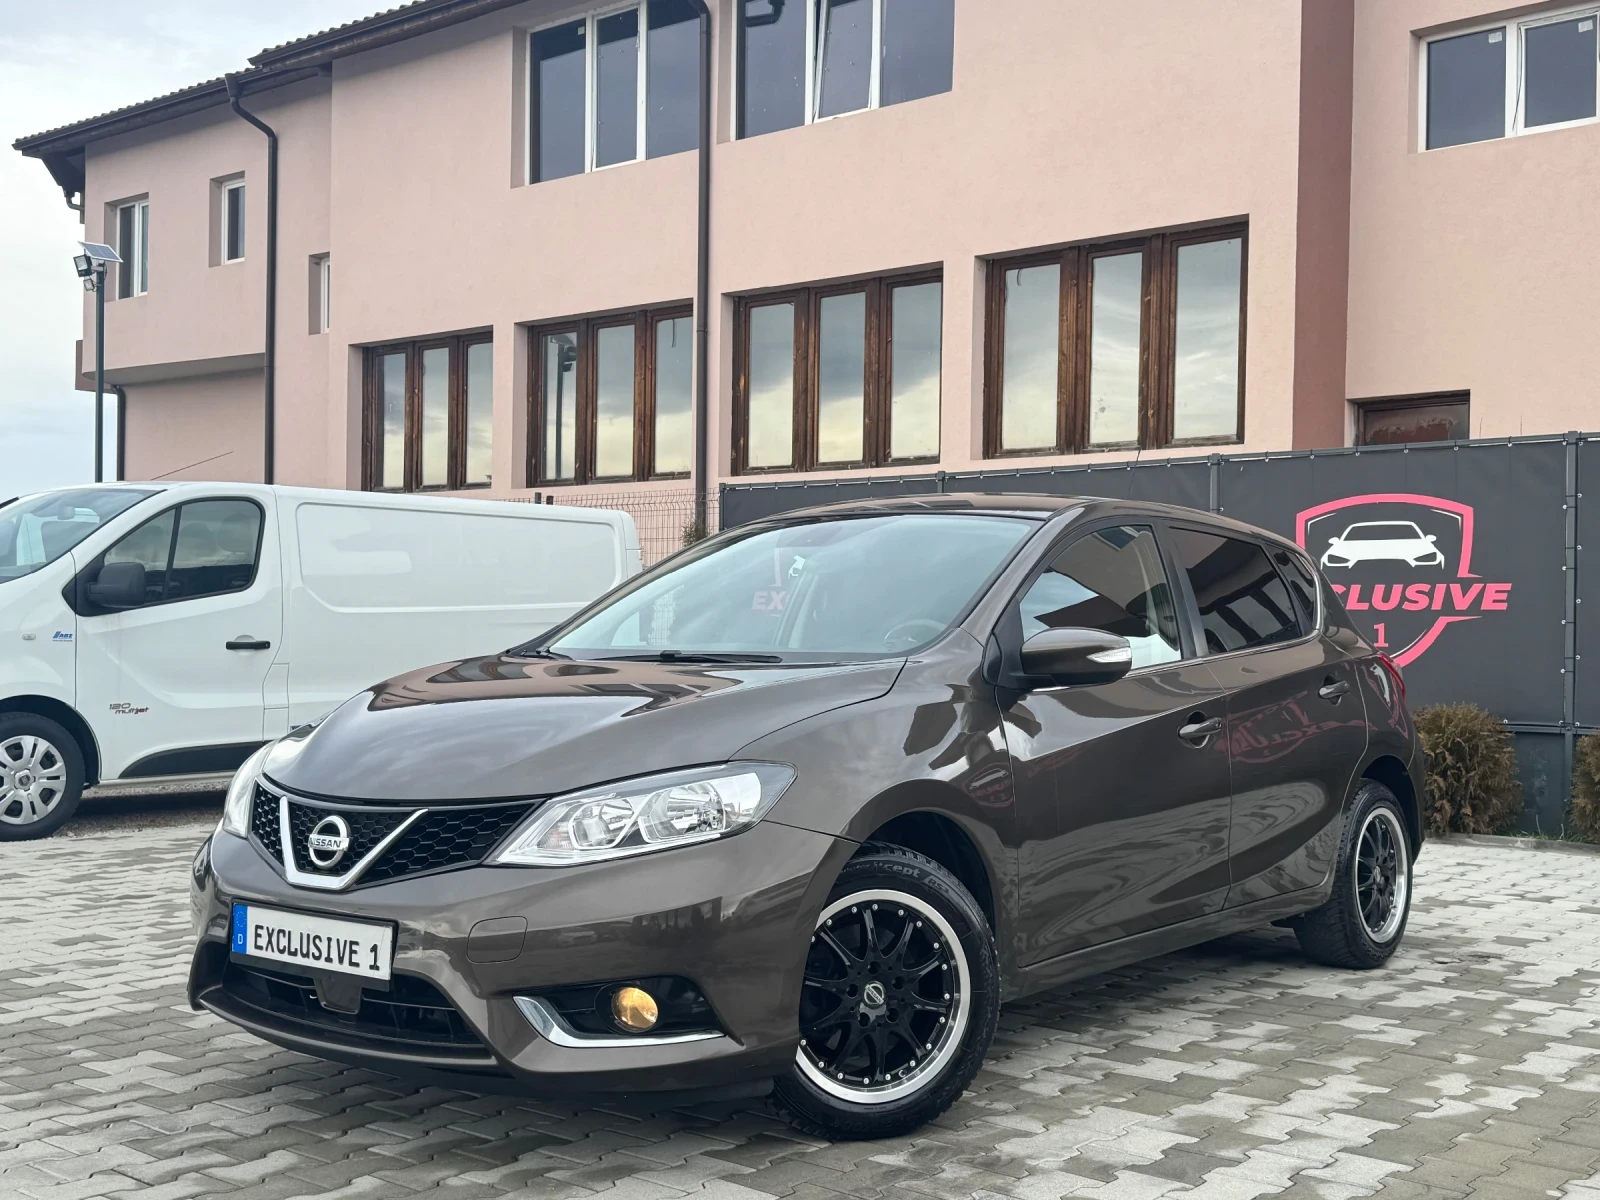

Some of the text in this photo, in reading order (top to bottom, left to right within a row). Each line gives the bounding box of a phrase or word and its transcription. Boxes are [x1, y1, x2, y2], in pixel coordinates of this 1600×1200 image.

[1330, 582, 1513, 611] LUSIVE
[1373, 622, 1389, 648] 1
[109, 702, 131, 710] 120
[309, 837, 342, 848] NISSAN
[237, 924, 381, 971] D EXCLUSIVE 1
